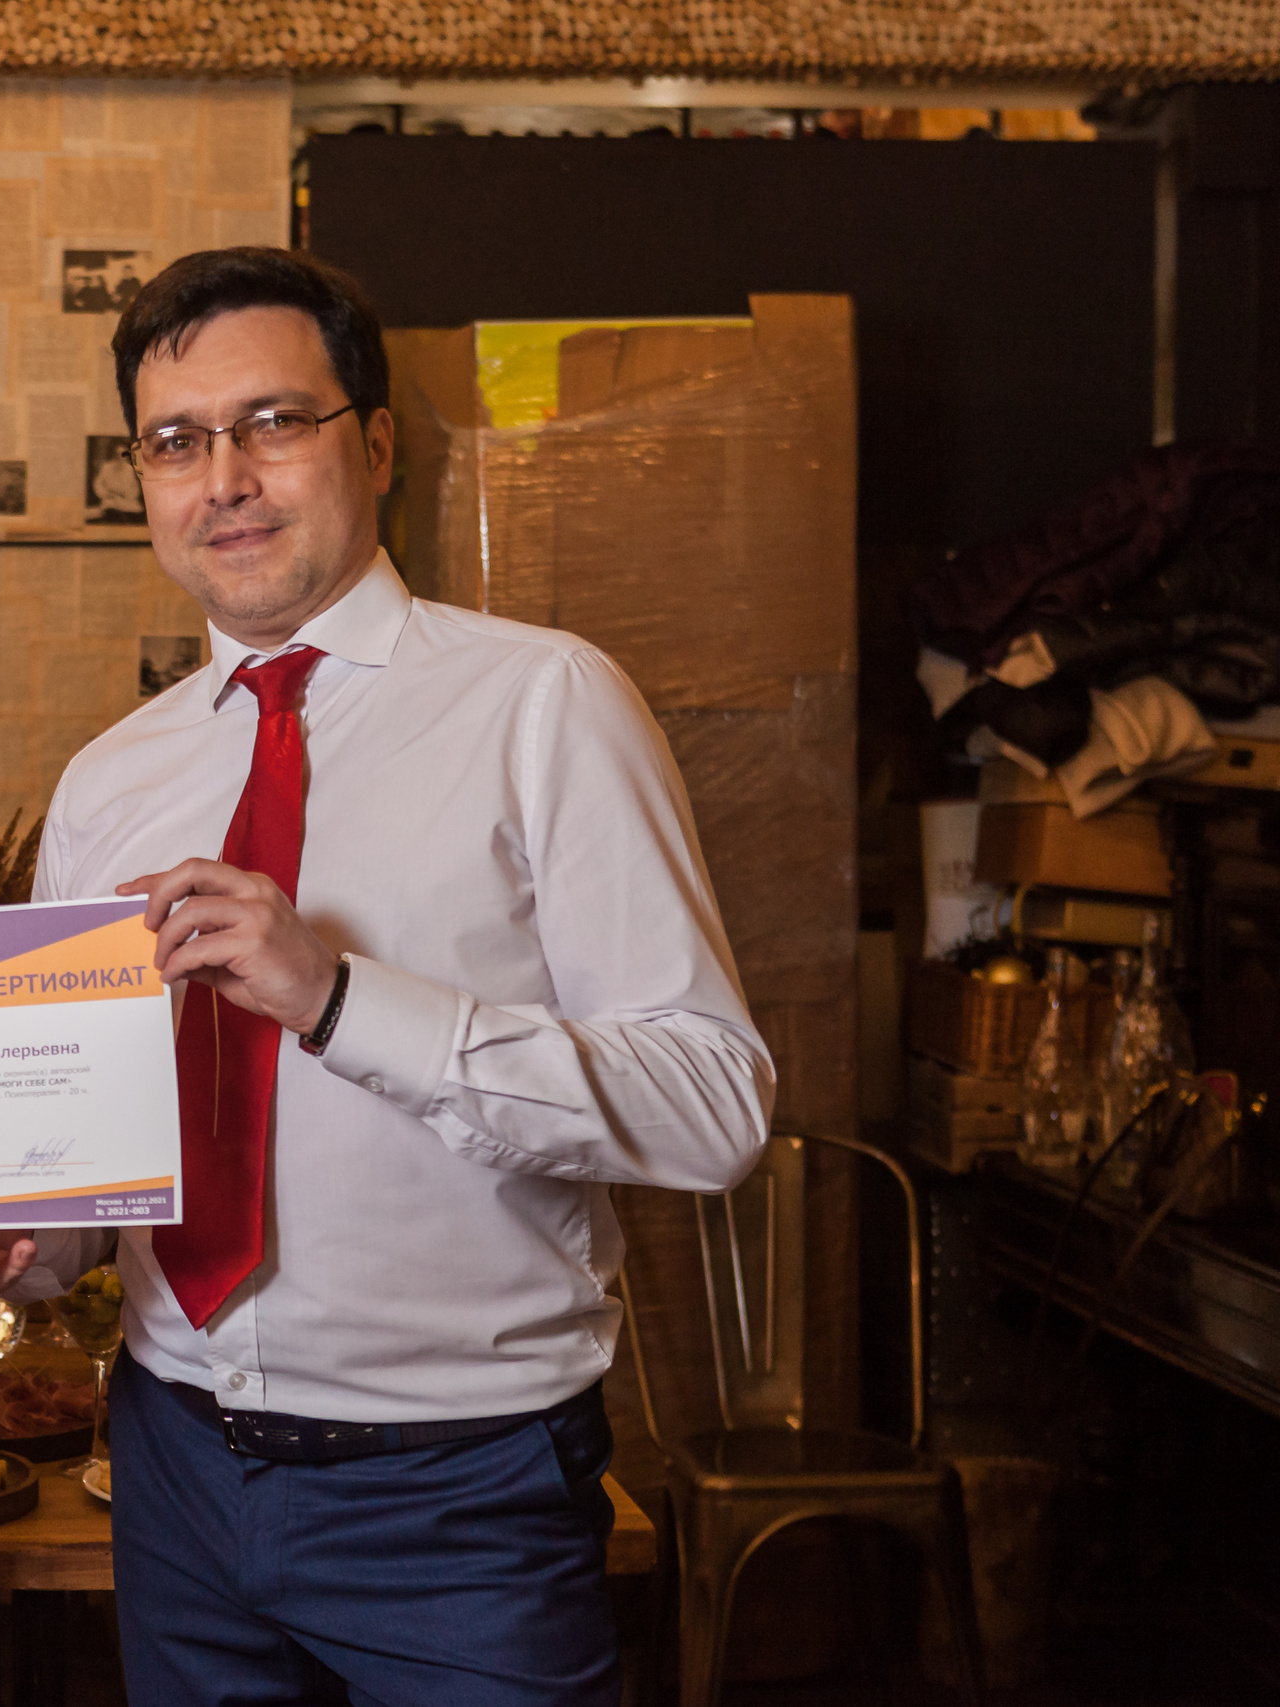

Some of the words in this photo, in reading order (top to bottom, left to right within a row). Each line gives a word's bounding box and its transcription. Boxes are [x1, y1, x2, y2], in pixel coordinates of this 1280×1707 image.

[24, 1079, 46, 1087] СЕБЕ
[48, 1077, 72, 1086] САМ»
[95, 1198, 123, 1206] Москва
[126, 1196, 167, 1205] 14.02.2021
[106, 1206, 150, 1216] 2021-003
